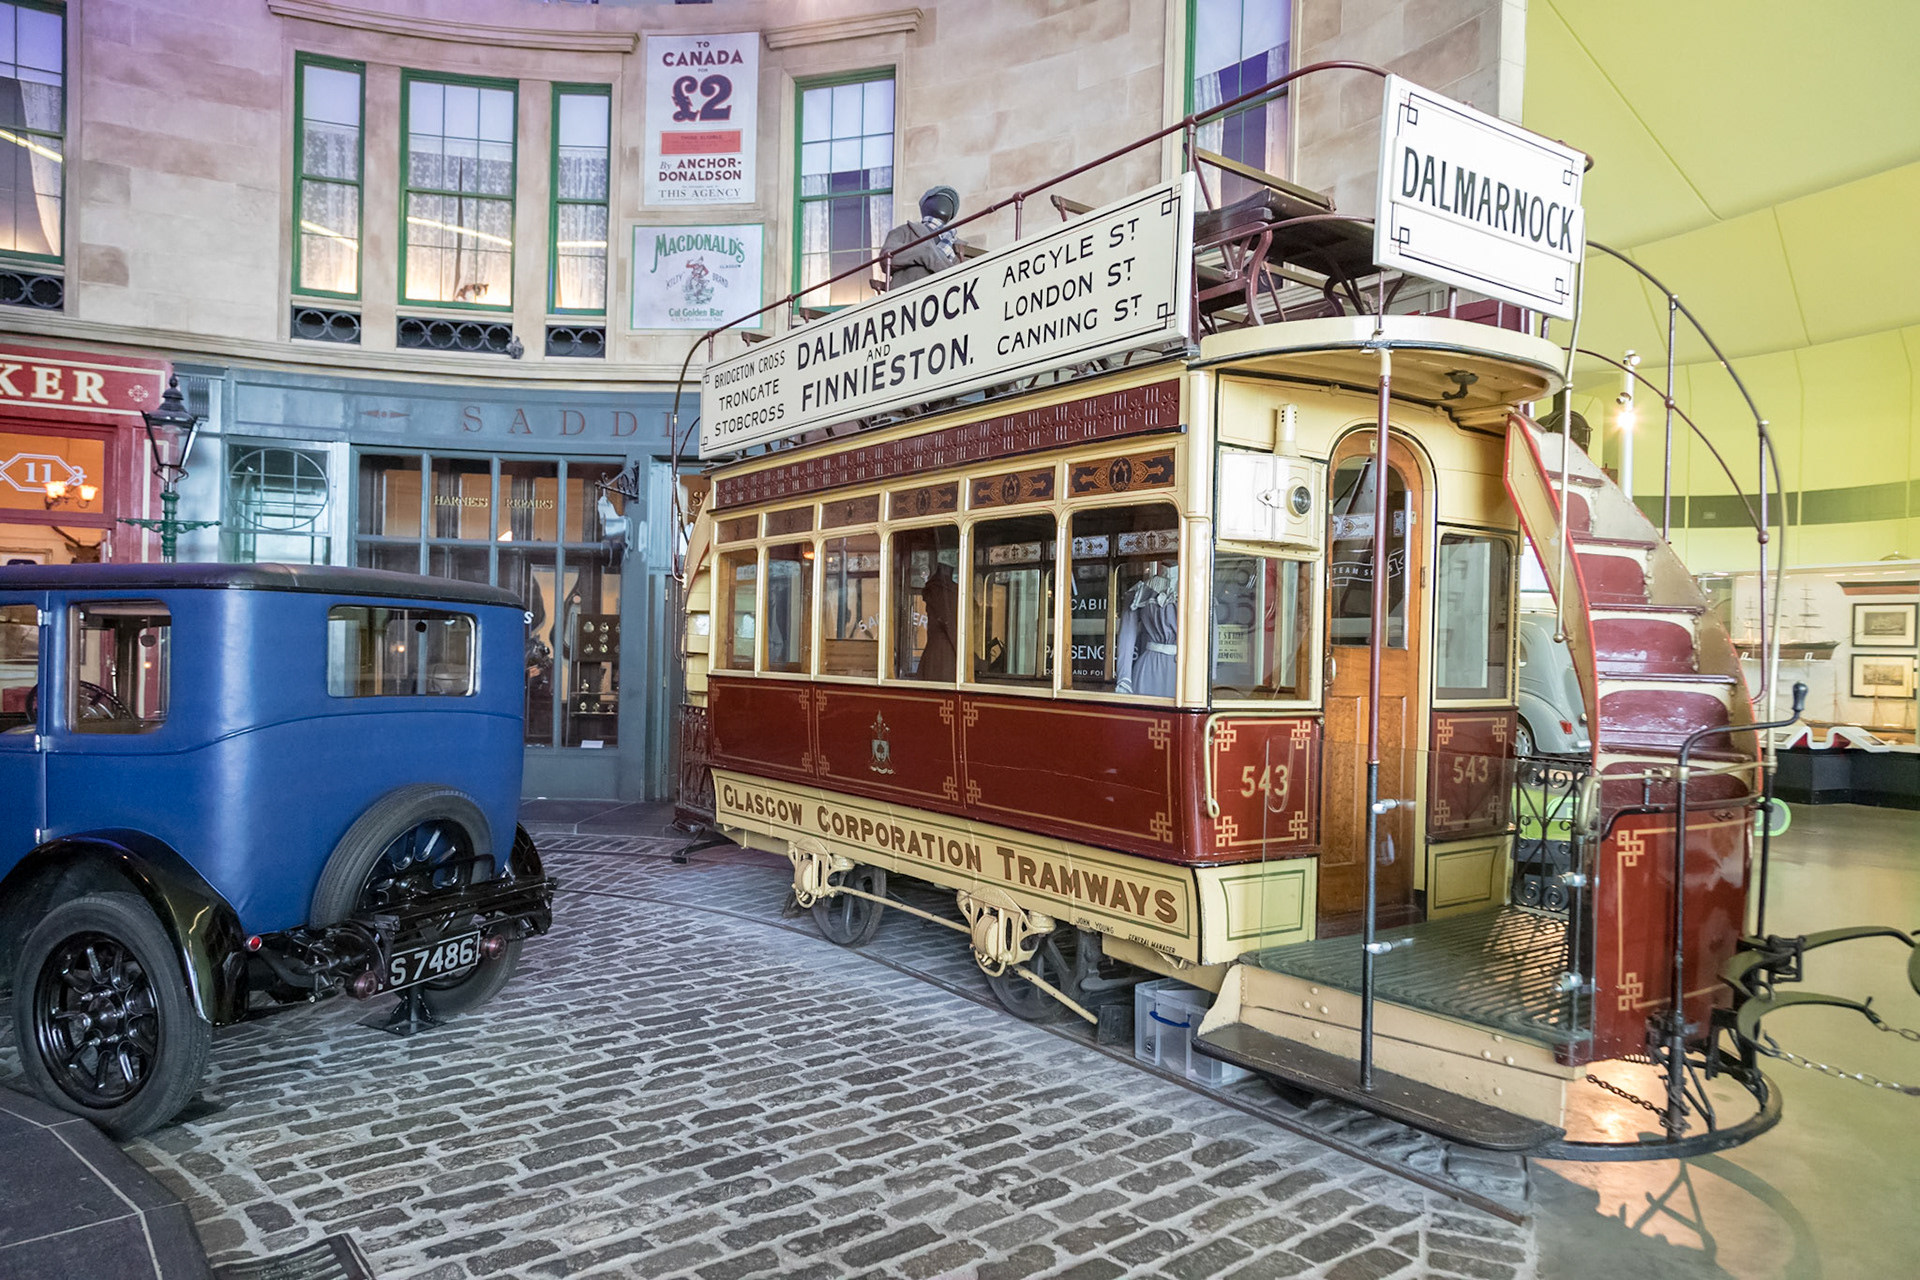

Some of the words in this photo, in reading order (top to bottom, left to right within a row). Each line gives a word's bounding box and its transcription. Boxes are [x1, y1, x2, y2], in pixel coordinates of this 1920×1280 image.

[662, 49, 744, 67] CANADA
[671, 74, 733, 123] £2
[659, 170, 742, 182] DONALDSON
[660, 161, 672, 171] By
[677, 157, 742, 169] ANCHOR-
[658, 189, 686, 198] THIS
[691, 187, 741, 198] AGENCY
[1402, 146, 1574, 254] DALMARNOCK
[1002, 234, 1093, 288] ARGYLE
[712, 272, 729, 289] BRAND
[1004, 271, 1093, 321] LONDON
[682, 307, 708, 317] Golden
[709, 308, 724, 317] Bar
[797, 276, 980, 370] DALMARNOCK
[997, 308, 1098, 356] CANNING
[714, 361, 755, 389] BRIDGETON
[758, 350, 786, 373] CROSS
[866, 344, 891, 362] AND
[719, 378, 780, 411] TRONGATE
[714, 403, 785, 437] STOBCROSS
[25, 462, 52, 483] 11
[434, 495, 489, 508] HARNESS
[505, 498, 554, 510] REPAIRS
[1240, 764, 1288, 798] 543
[1453, 755, 1489, 784] 543
[723, 784, 802, 826] GLASGOW
[817, 805, 982, 873] CORPORATION
[996, 846, 1178, 924] TRAMWAYS
[1076, 917, 1091, 927] JOHN
[1095, 922, 1115, 935] YOUNG
[1127, 934, 1149, 946] GENERAL
[1150, 941, 1177, 954] MANAGER
[412, 938, 475, 981] 7486
